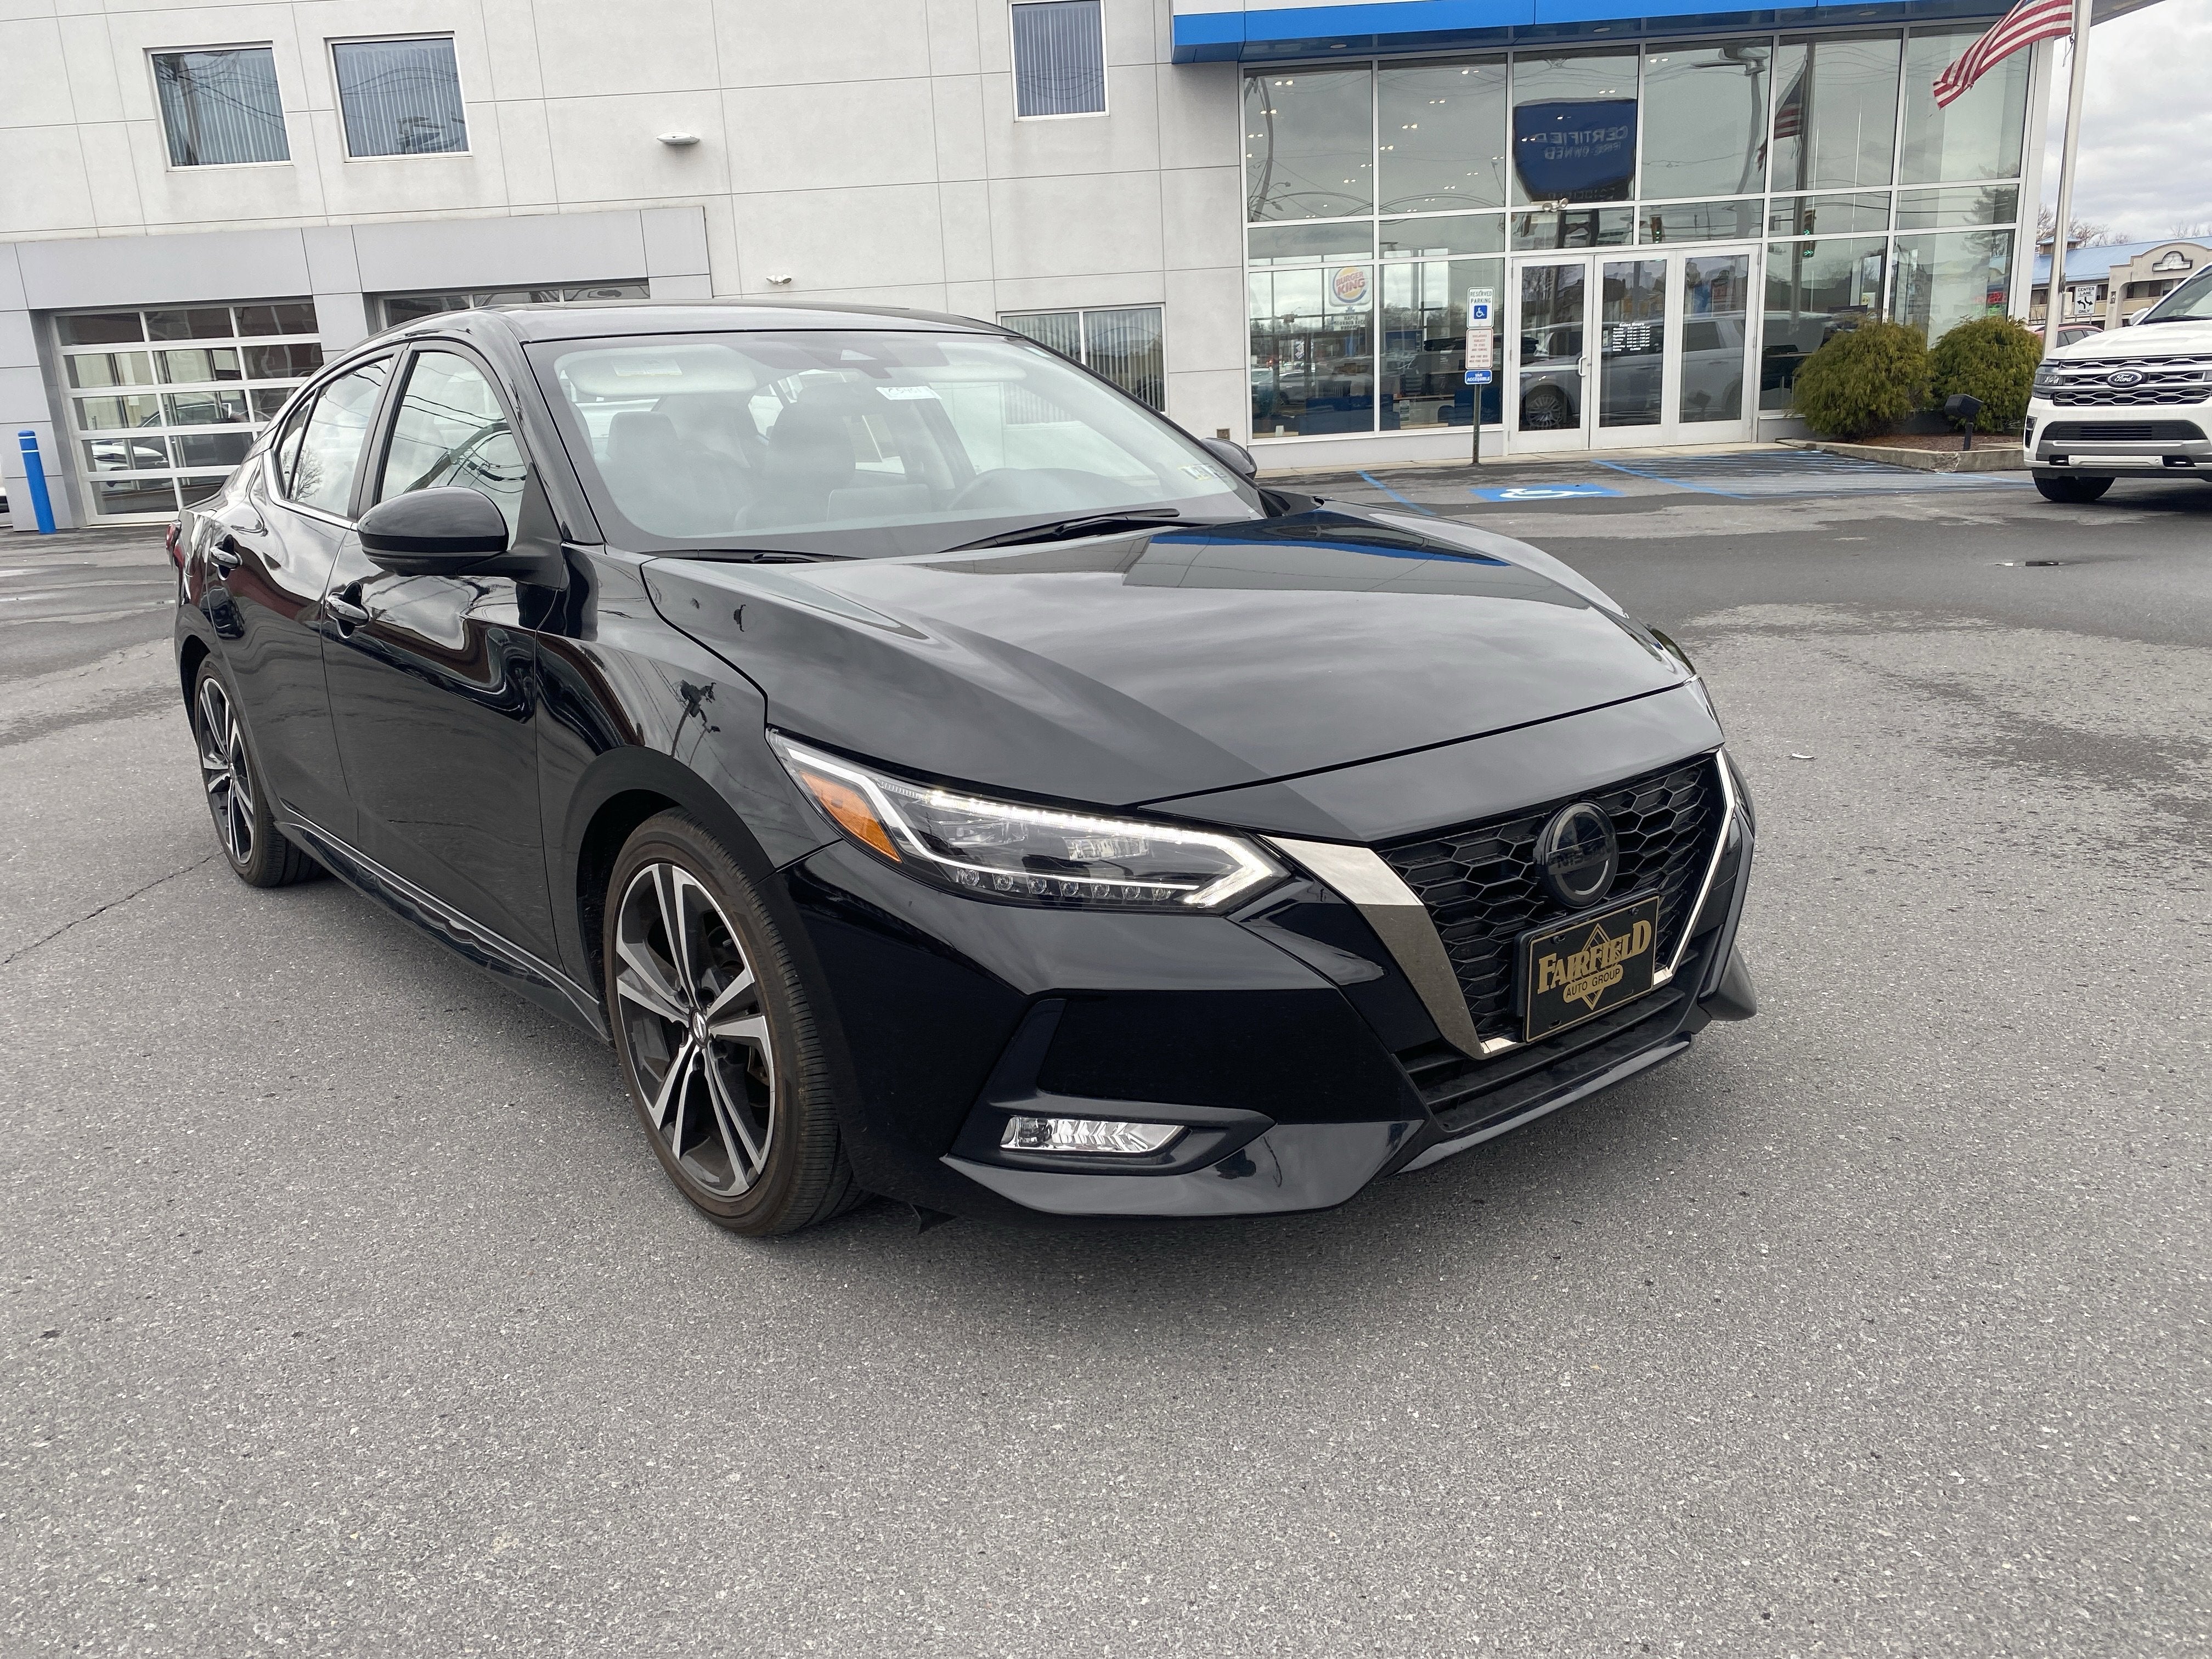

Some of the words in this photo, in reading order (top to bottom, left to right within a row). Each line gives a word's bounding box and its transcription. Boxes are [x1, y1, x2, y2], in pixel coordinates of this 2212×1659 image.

[1336, 271, 1364, 287] BURGER
[1337, 278, 1365, 296] KING
[1537, 920, 1652, 994] FAIRFIELD
[1566, 981, 1588, 997] AUTO
[1592, 968, 1620, 987] GROUP
